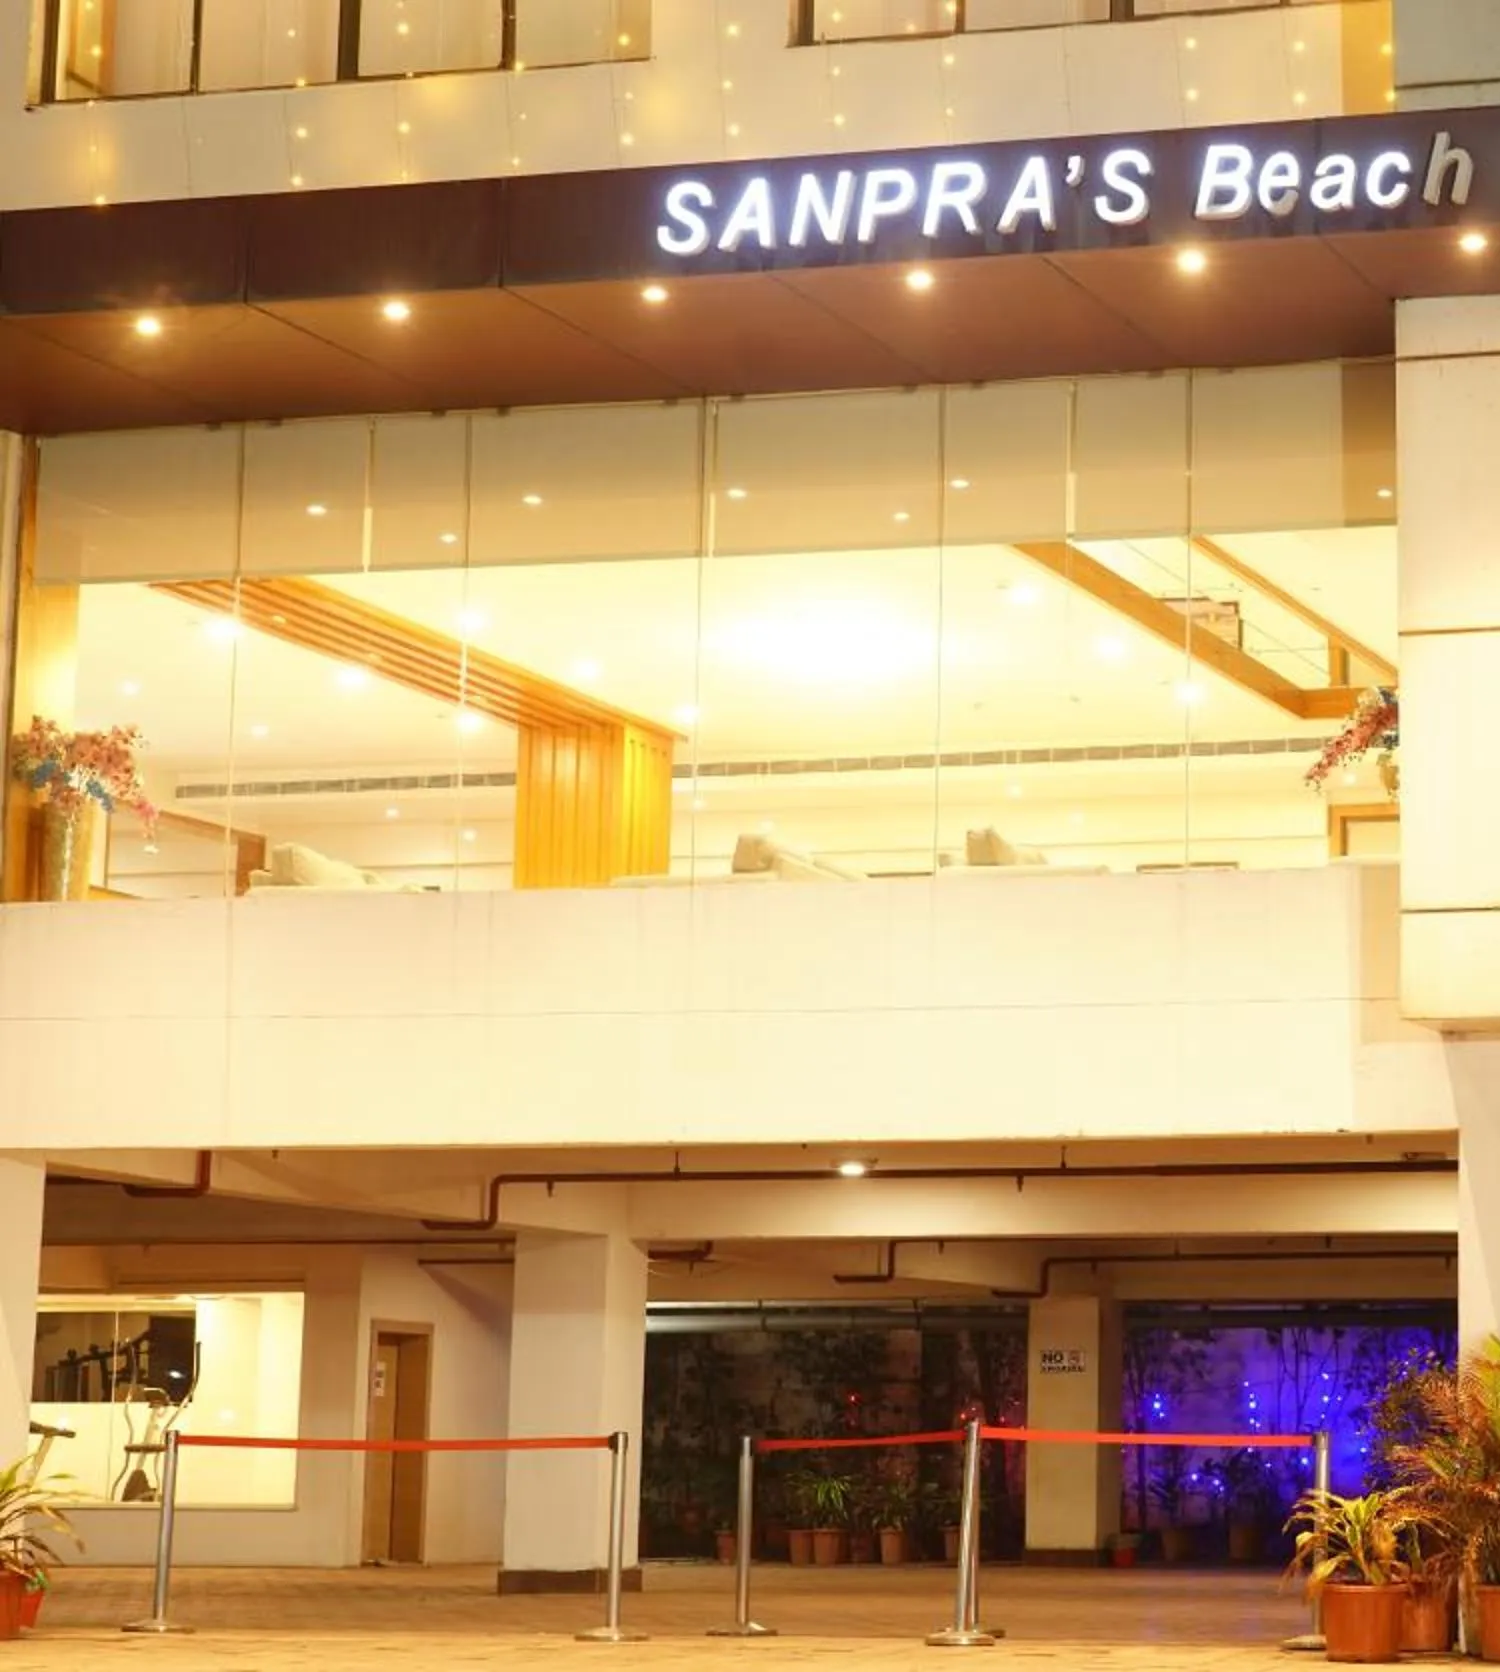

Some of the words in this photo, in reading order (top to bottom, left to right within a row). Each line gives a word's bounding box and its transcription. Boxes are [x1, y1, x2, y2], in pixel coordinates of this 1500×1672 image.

[656, 150, 1153, 257] SANPRA'S
[1195, 131, 1475, 219] Beach
[1041, 1350, 1064, 1364] NO
